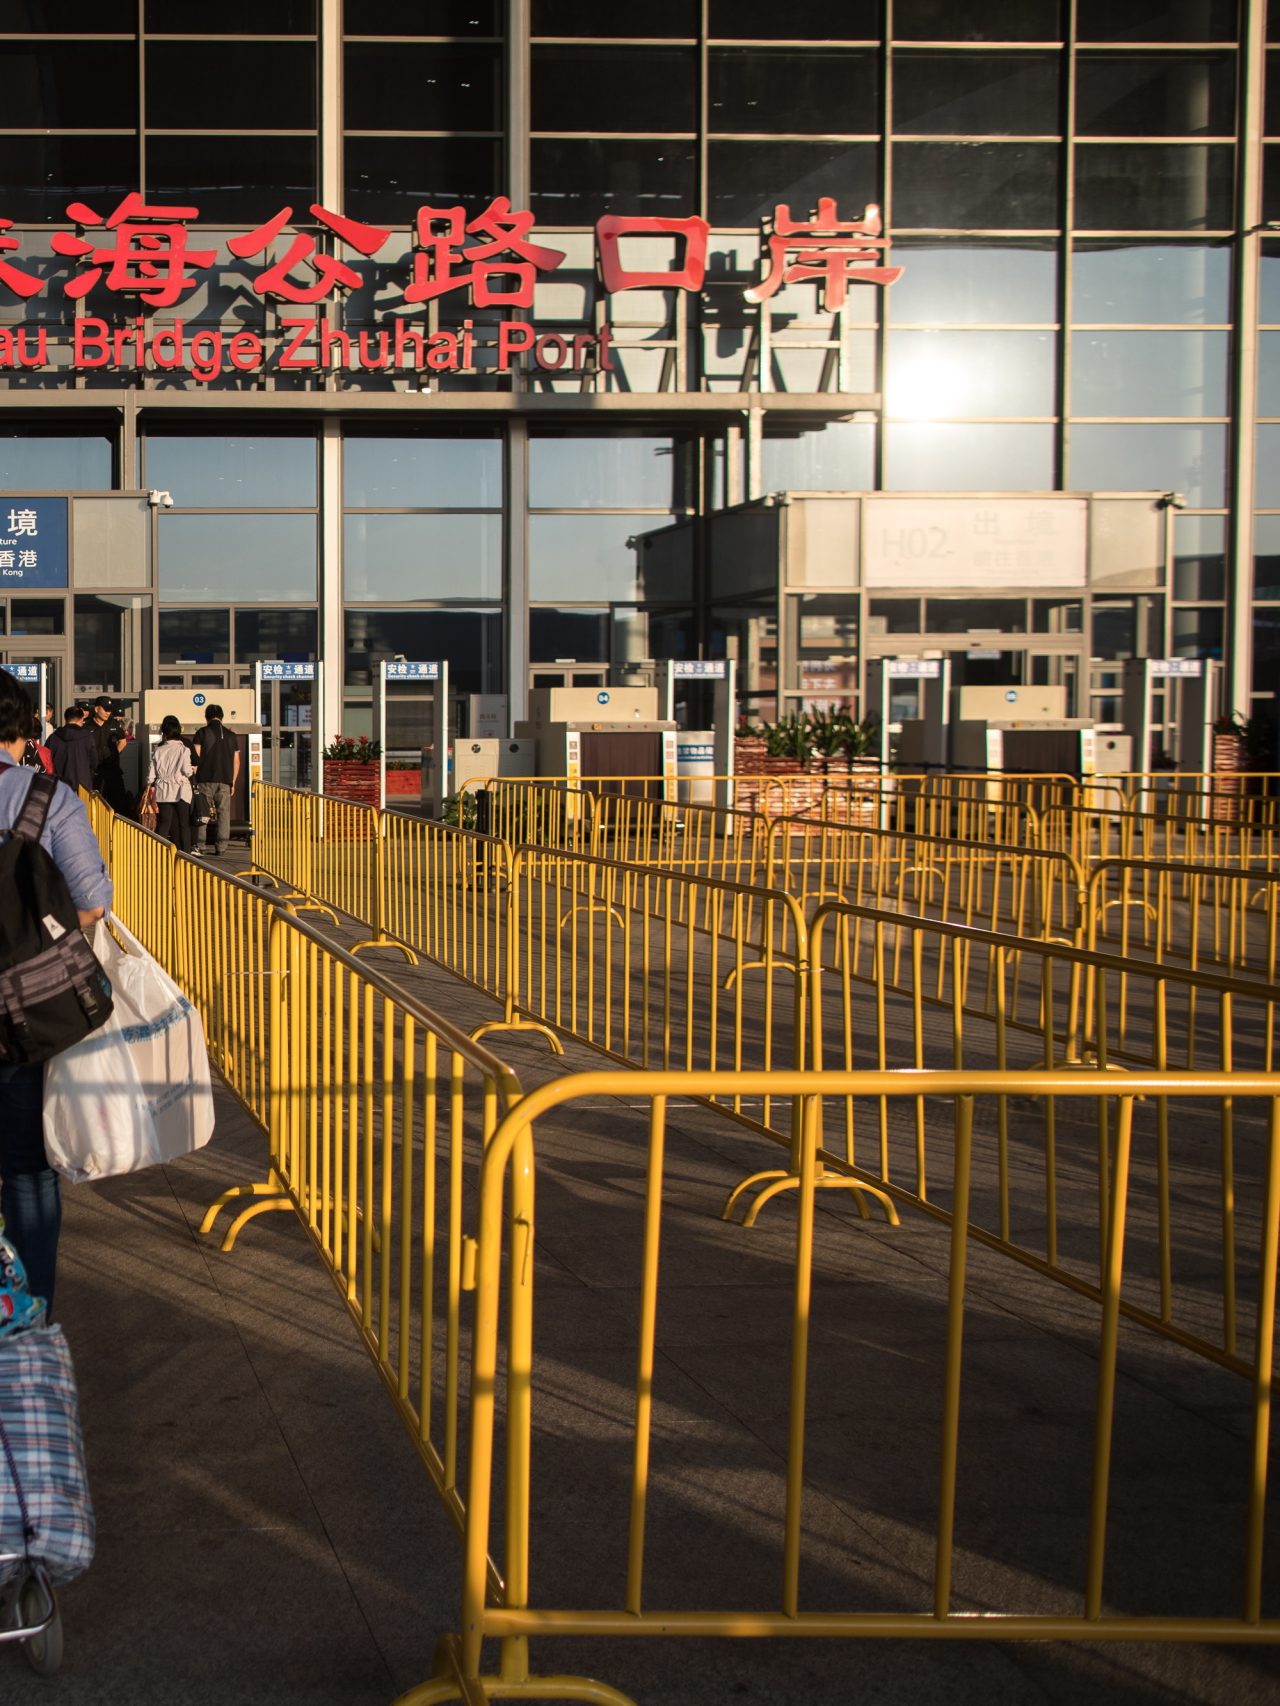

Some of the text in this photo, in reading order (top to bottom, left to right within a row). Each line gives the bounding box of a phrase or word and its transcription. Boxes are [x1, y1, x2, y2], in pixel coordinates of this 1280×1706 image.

[75, 317, 262, 382] Bridge
[279, 318, 473, 371] Zhuhai
[499, 321, 615, 371] Port
[881, 528, 947, 558] H02
[2, 569, 23, 577] Kong
[263, 664, 315, 675] 安检 通道
[387, 664, 438, 674] 安检 通道
